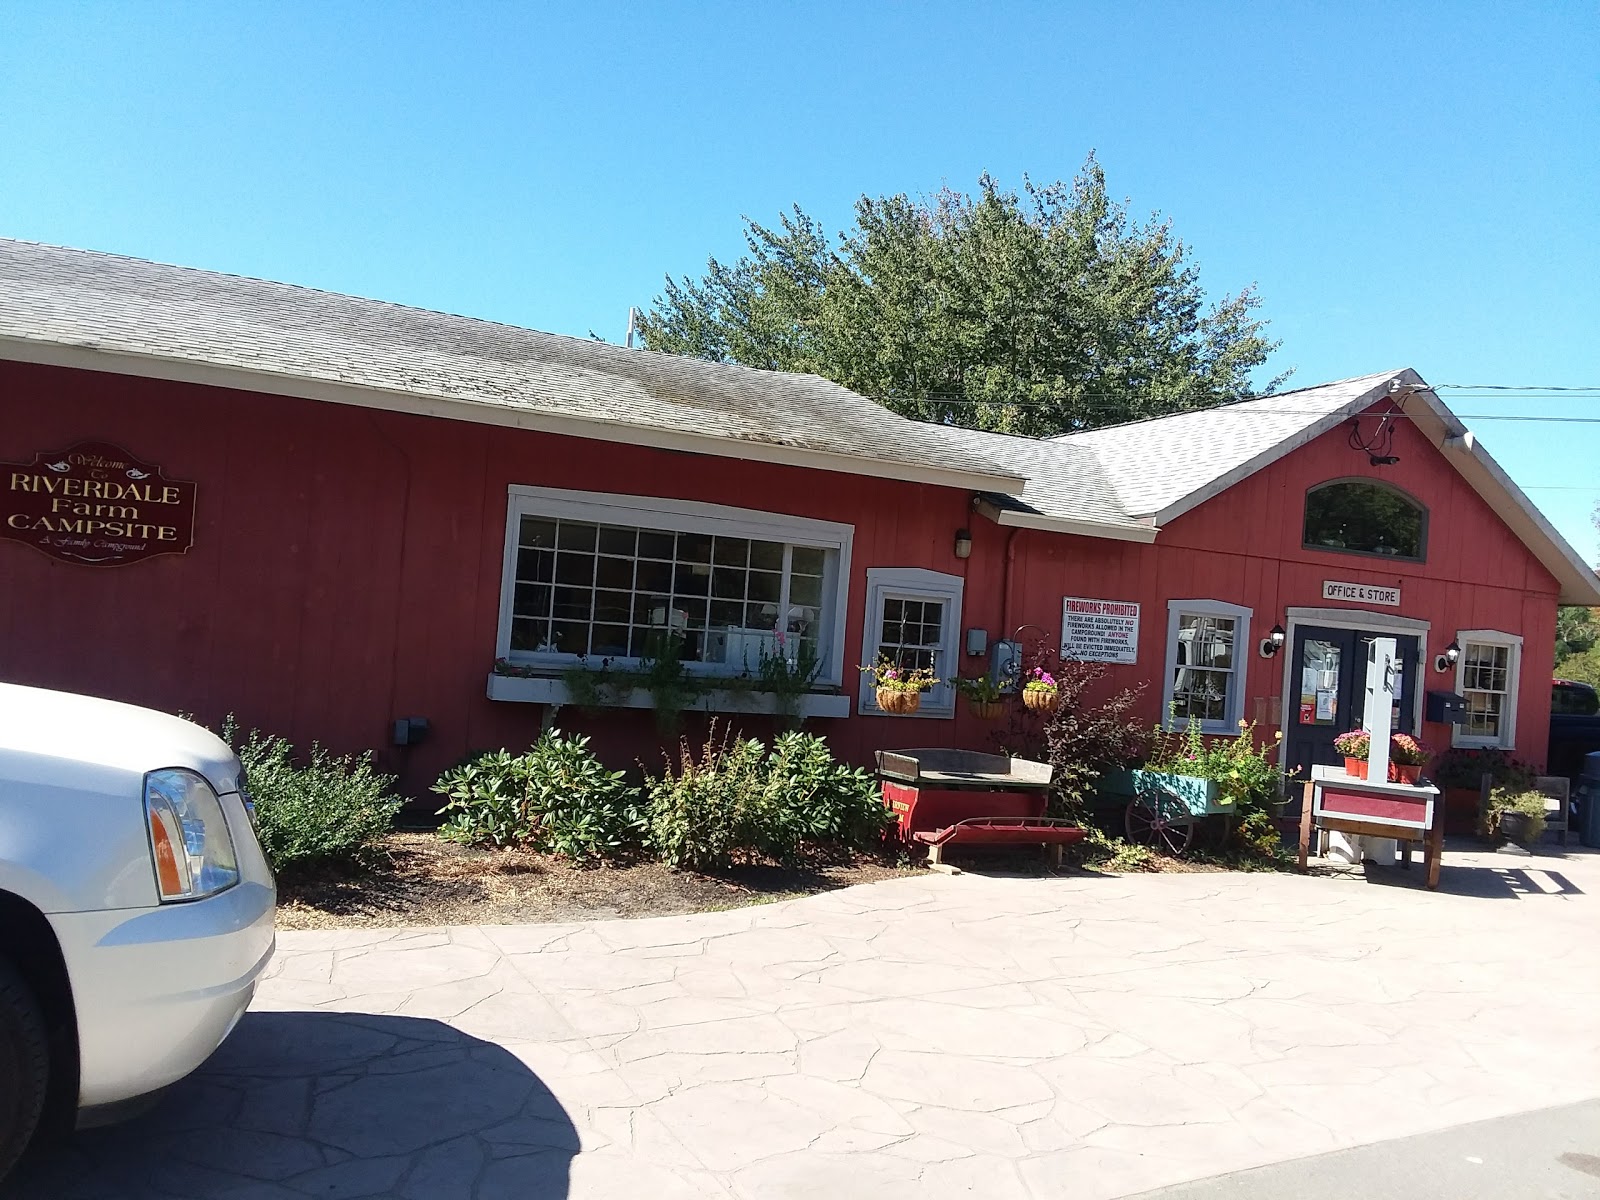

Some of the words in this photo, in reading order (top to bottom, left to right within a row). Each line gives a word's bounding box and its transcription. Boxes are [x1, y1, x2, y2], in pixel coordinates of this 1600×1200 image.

[68, 453, 128, 470] Welcome
[10, 472, 181, 505] RIVERDALE
[51, 498, 139, 520] Farm
[7, 513, 178, 541] CAMPSITE
[54, 536, 91, 549] Family
[94, 539, 147, 552] Campground
[1327, 584, 1356, 598] OFFICE
[1359, 588, 1365, 598] &
[1367, 589, 1396, 602] STORE
[1066, 600, 1102, 614] FIREWORKS
[1102, 603, 1138, 616] PROHIBITED
[1067, 621, 1095, 630] FIREWORKS
[1094, 617, 1124, 625] ABSOLUTELY
[1083, 643, 1103, 651] EVICTED
[1088, 650, 1119, 658] EXCEPTIONS
